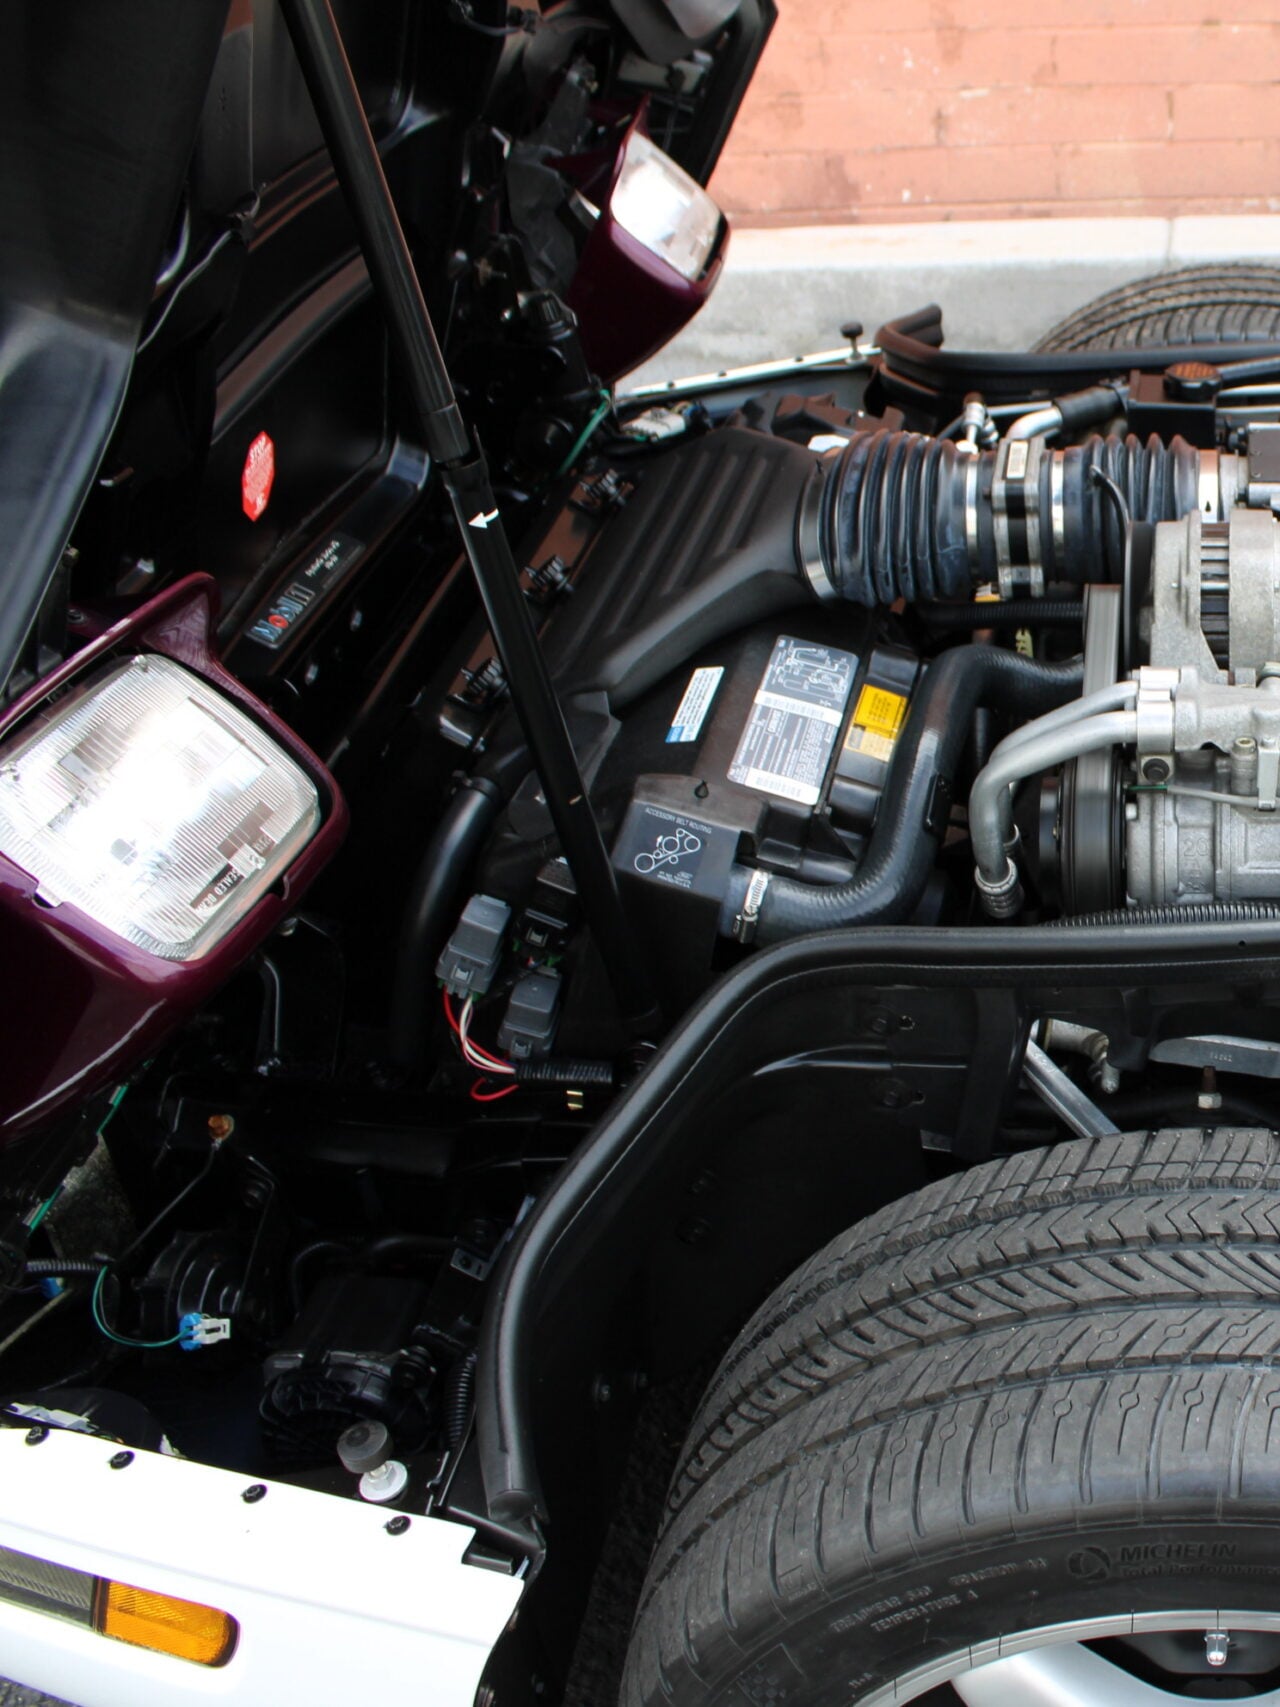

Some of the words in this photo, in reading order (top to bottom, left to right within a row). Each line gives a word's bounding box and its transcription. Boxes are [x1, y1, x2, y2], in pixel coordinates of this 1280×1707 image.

[252, 597, 302, 641] Mobil
[644, 807, 677, 822] ACCESSORY
[675, 816, 689, 827] BELT
[688, 820, 713, 833] ROUTING
[214, 869, 240, 897] SEALED
[1120, 1543, 1237, 1561] MICHELIN
[1121, 1564, 1163, 1577] Total
[872, 1594, 960, 1632] TEMPERATURE
